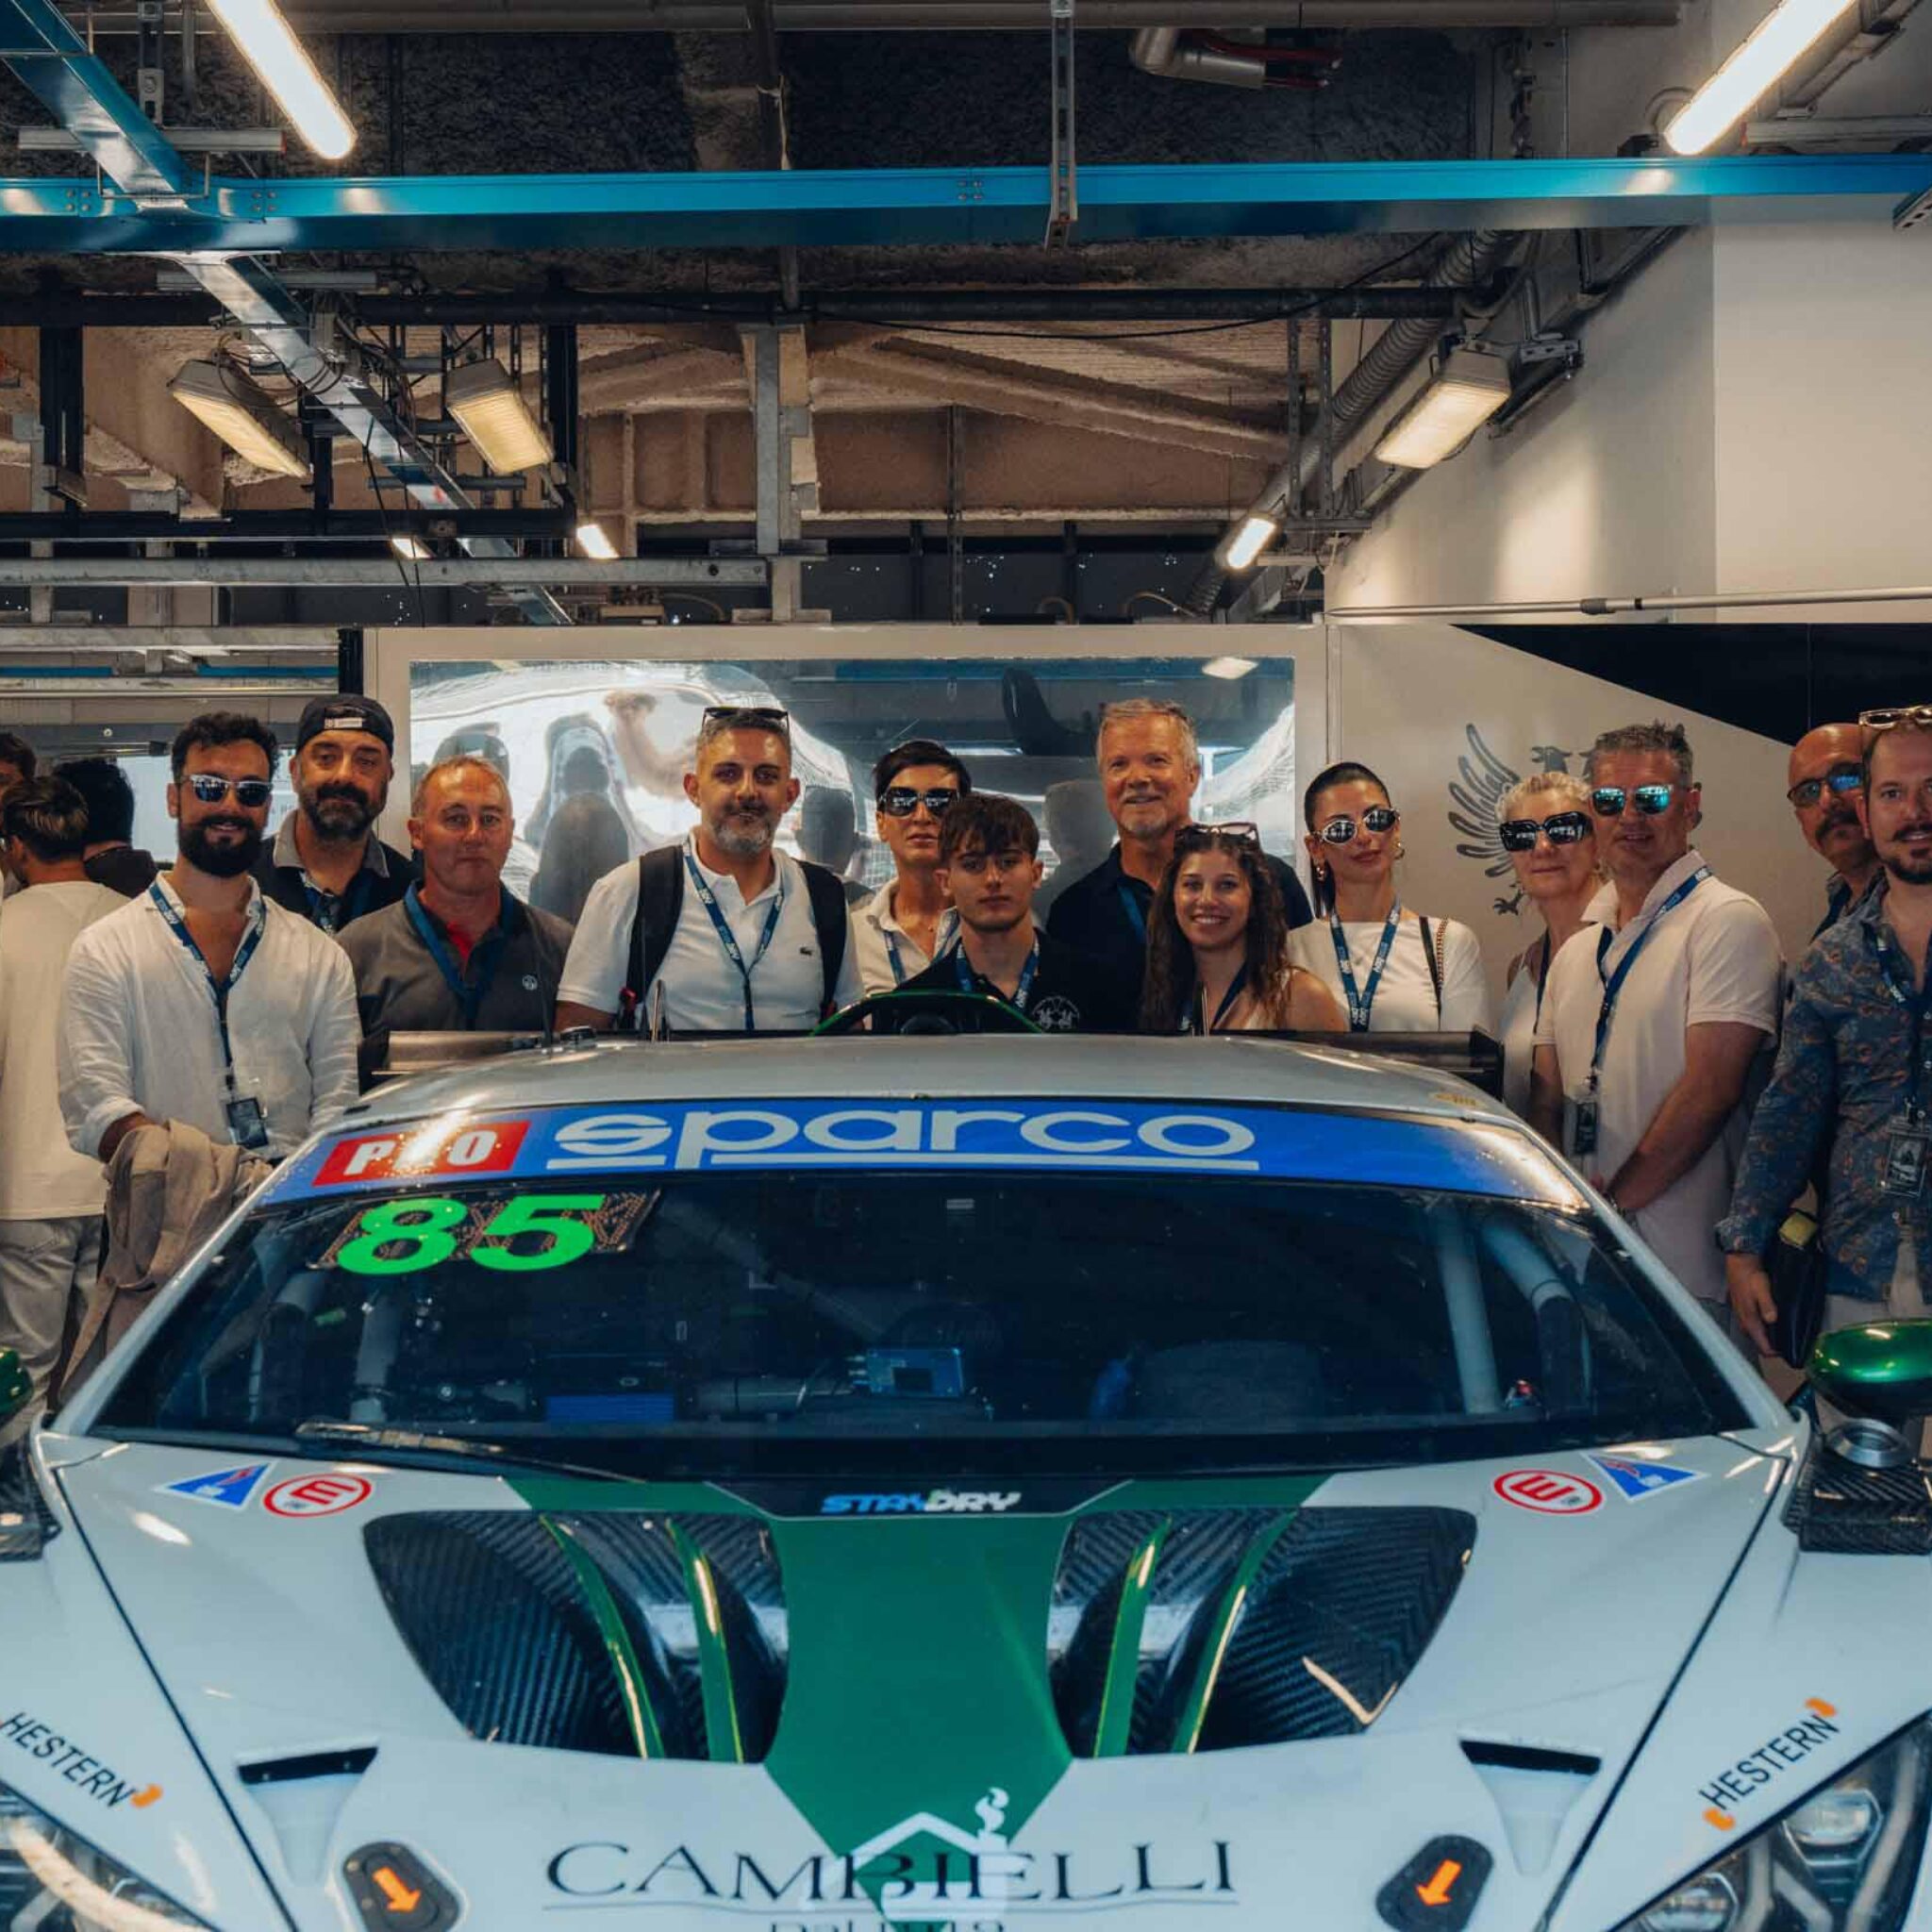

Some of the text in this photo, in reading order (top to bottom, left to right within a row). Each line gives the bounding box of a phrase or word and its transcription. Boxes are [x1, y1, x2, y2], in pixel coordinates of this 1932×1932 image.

[554, 1108, 1255, 1171] sparco
[336, 1194, 607, 1274] 85
[0, 1711, 138, 1808] HESTERN
[1698, 1714, 1840, 1810] HESTERN
[545, 1840, 1232, 1902] CAMBIELLI
